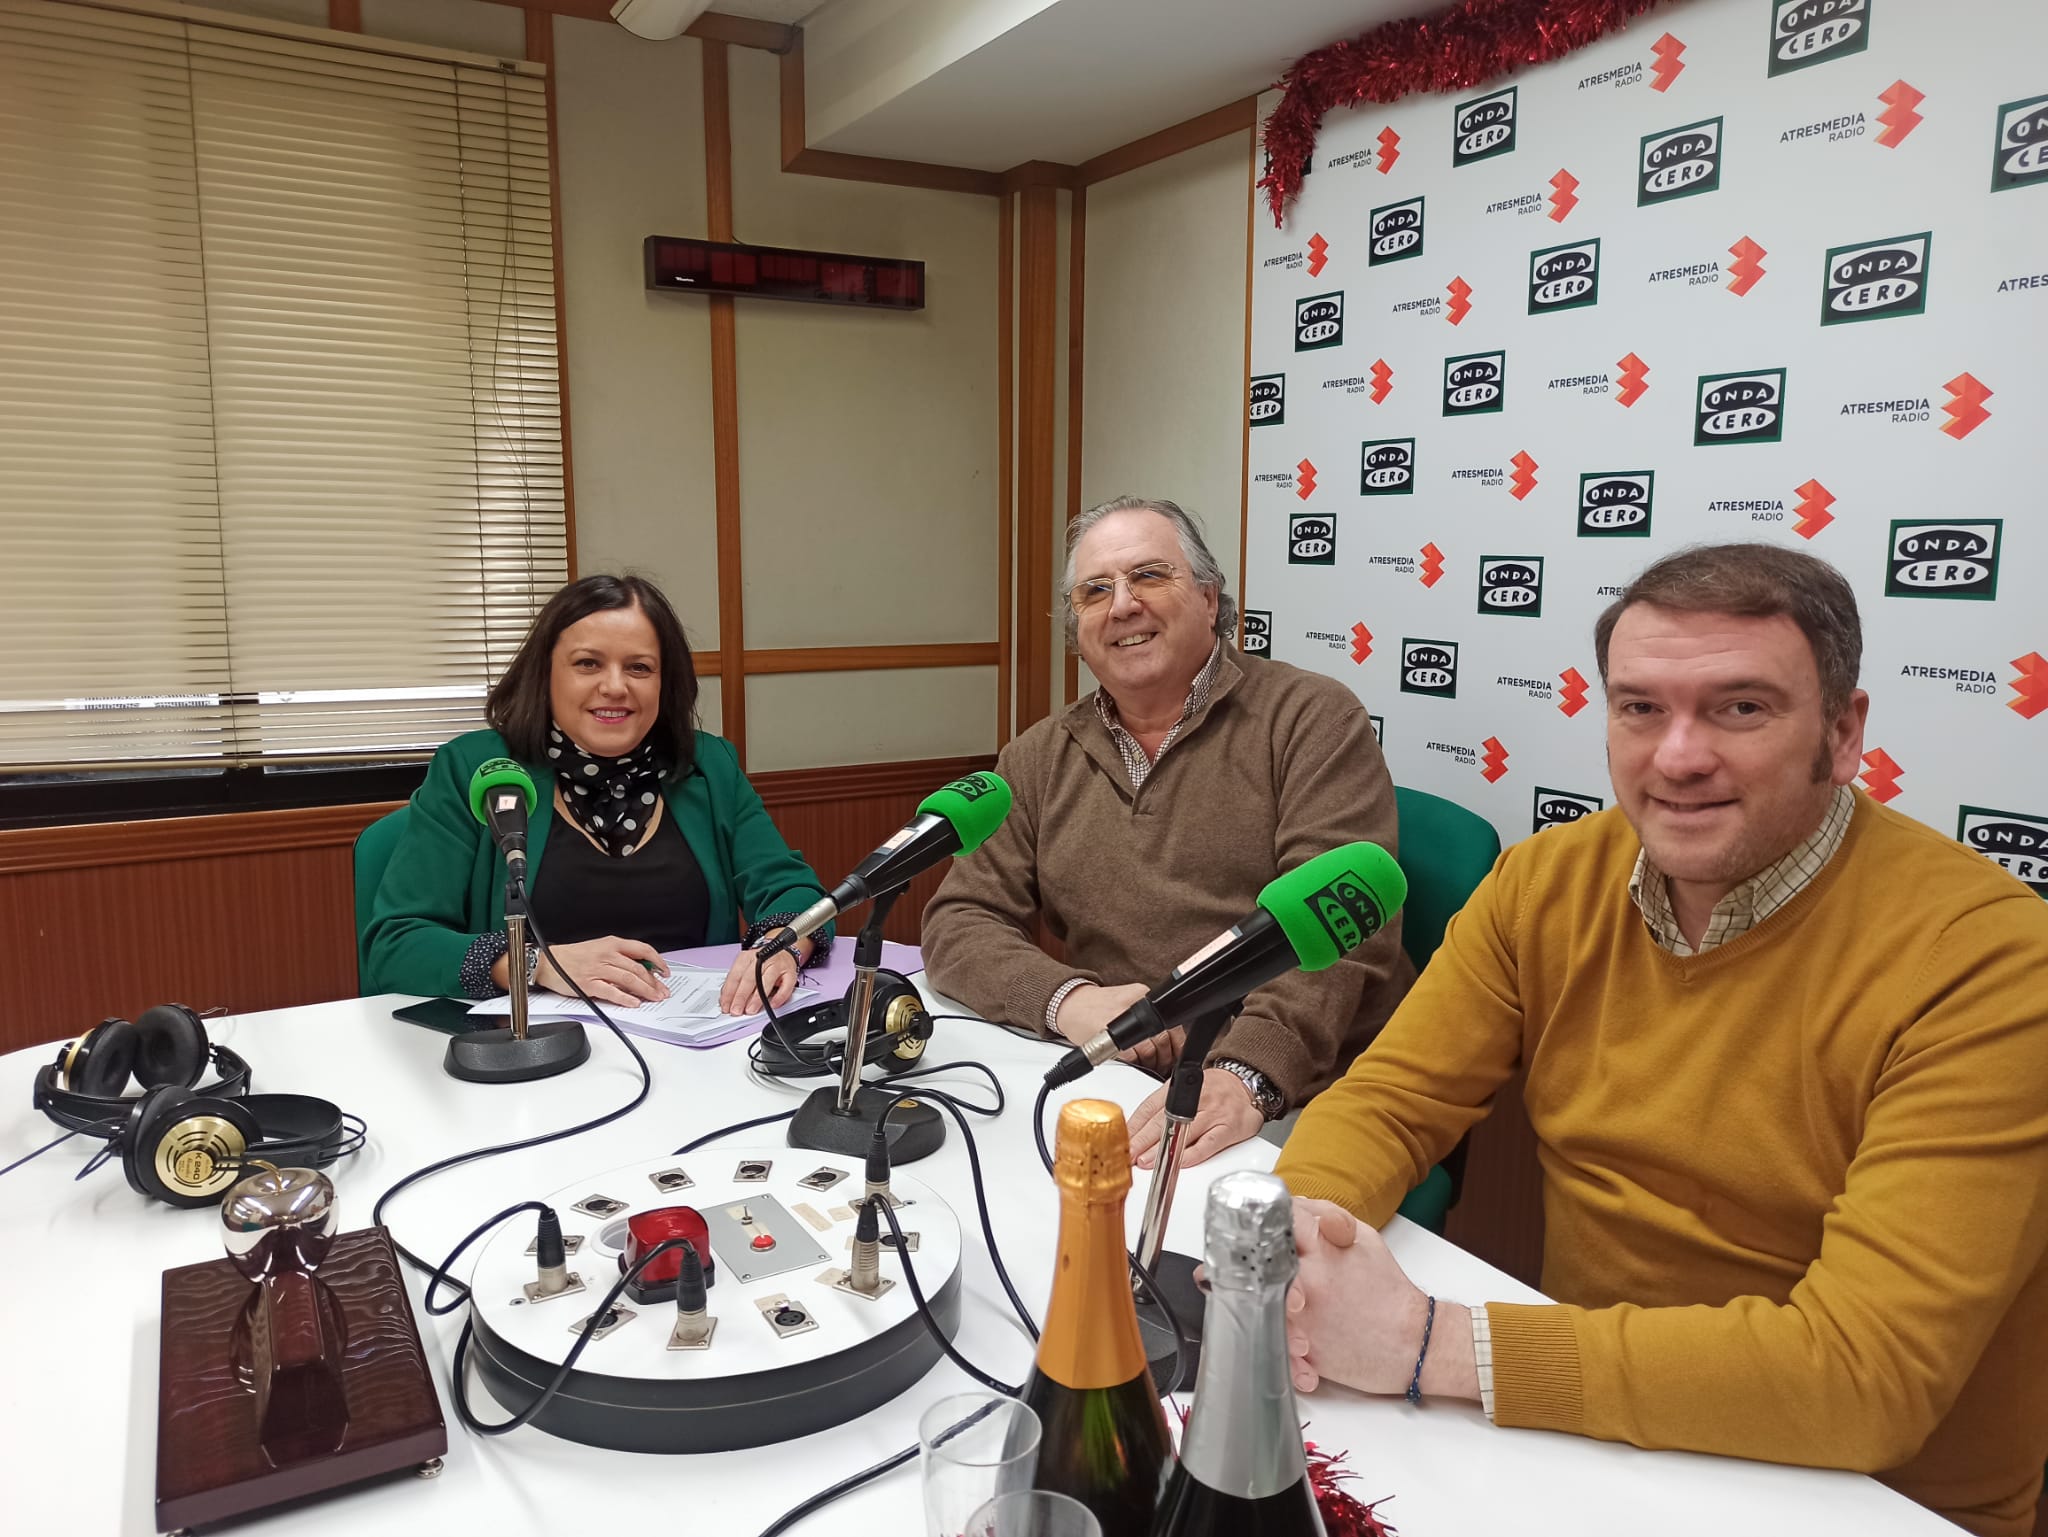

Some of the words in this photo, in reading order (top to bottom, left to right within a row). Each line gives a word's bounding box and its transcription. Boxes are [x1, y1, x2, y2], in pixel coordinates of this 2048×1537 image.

[1789, 23, 1850, 54] CERO
[1578, 62, 1642, 90] ATRESMEDIA
[1615, 72, 1642, 89] RADIO
[1464, 105, 1507, 129] ONDA
[1779, 112, 1866, 144] ATRESMEDIA
[1828, 125, 1866, 144] RADIO
[1465, 127, 1504, 151] CERO
[1653, 138, 1706, 164] ONDA
[1328, 149, 1372, 168] ATRESMEDIA
[1353, 157, 1372, 170] RADIO
[1654, 163, 1705, 189] CERO
[1486, 193, 1542, 215] ATRESMEDIA
[1517, 204, 1542, 216] RADIO
[1378, 212, 1415, 232] ONDA
[1379, 232, 1413, 251] CERO
[1263, 252, 1303, 268] ATRESMEDIA
[1286, 260, 1303, 270] RADIO
[1541, 257, 1587, 277] ONDA
[1841, 256, 1908, 278] ONDA
[1648, 262, 1719, 283] ATRESMEDIA
[1689, 274, 1719, 286] RADIO
[1541, 278, 1585, 299] CERO
[1843, 283, 1907, 307] CERO
[1393, 297, 1441, 313] ATRESMEDIA
[1420, 306, 1441, 316] RADIO
[1304, 305, 1335, 320] ONDA
[1304, 324, 1334, 338] CERO
[1454, 366, 1494, 383] ONDA
[1322, 377, 1365, 389] ATRESMEDIA
[1548, 374, 1609, 390] ATRESMEDIA
[1346, 385, 1365, 394] RADIO
[1455, 387, 1492, 402] CERO
[1583, 384, 1609, 395] RADIO
[1711, 388, 1768, 405] ONDA
[1250, 404, 1276, 416] CERO
[1840, 398, 1931, 415] ATRESMEDIA
[1712, 412, 1766, 430] CERO
[1891, 412, 1931, 424] RADIO
[1370, 451, 1405, 464] ONDA
[1254, 473, 1293, 483] ATRESMEDIA
[1371, 470, 1404, 483] CERO
[1451, 469, 1504, 480] ATRESMEDIA
[1276, 481, 1293, 489] RADIO
[1481, 477, 1504, 487] RADIO
[1591, 486, 1640, 500] ONDA
[1708, 500, 1784, 512] ATRESMEDIA
[1592, 509, 1638, 523] CERO
[1751, 512, 1784, 521] RADIO
[1296, 525, 1328, 536] ONDA
[1297, 542, 1327, 554] CERO
[1906, 539, 1978, 553] ONDA
[1368, 556, 1415, 567] ATRESMEDIA
[1395, 565, 1415, 574] RADIO
[1489, 569, 1532, 581] ONDA
[1908, 565, 1976, 581] CERO
[1491, 589, 1531, 603] CERO
[1305, 631, 1346, 643] ATRESMEDIA
[1410, 652, 1447, 664] ONDA
[1411, 671, 1446, 684] CERO
[1901, 665, 1997, 683] ATRESMEDIA
[1497, 676, 1552, 690] ATRESMEDIA
[1956, 682, 1996, 695] RADIO
[1528, 688, 1552, 699] RADIO
[1426, 741, 1476, 757] ATRESMEDIA
[1455, 754, 1476, 765] RADIO
[1545, 803, 1588, 817] OND
[1985, 855, 2048, 879] ERO
